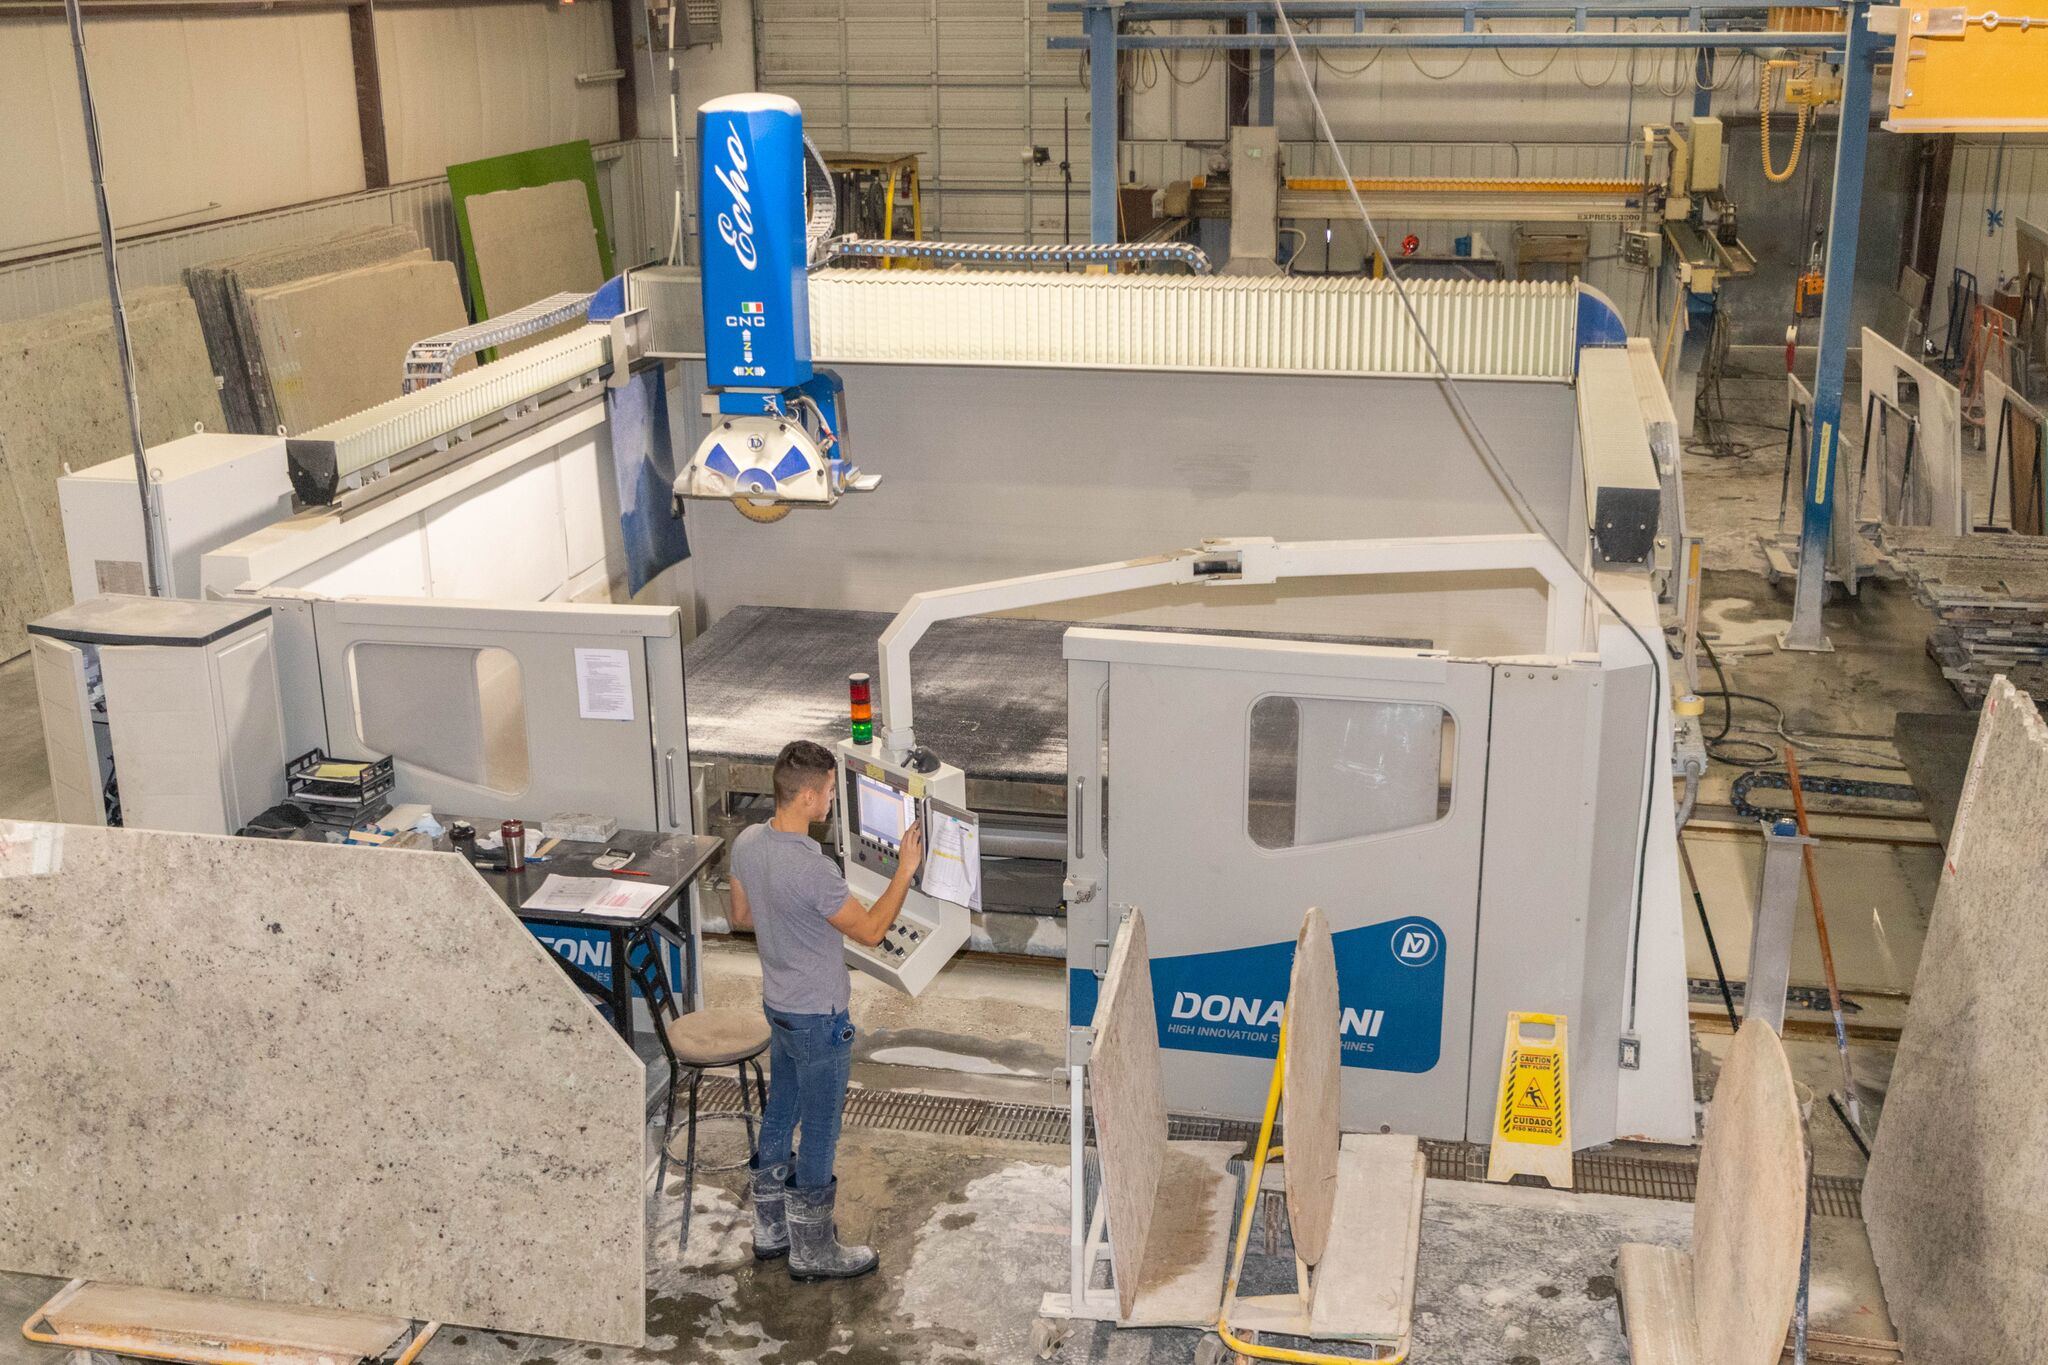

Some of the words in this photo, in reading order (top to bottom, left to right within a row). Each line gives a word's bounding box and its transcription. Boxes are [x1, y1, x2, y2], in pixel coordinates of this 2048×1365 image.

[714, 120, 757, 271] Echo
[1577, 213, 1617, 221] EXPRESS
[726, 316, 765, 327] CNC
[1171, 991, 1384, 1037] DONANI
[1168, 1024, 1196, 1035] HIGH
[1197, 1027, 1268, 1042] INNOVATION
[1340, 1041, 1375, 1053] HINES
[1513, 1117, 1553, 1126] CUIDADO
